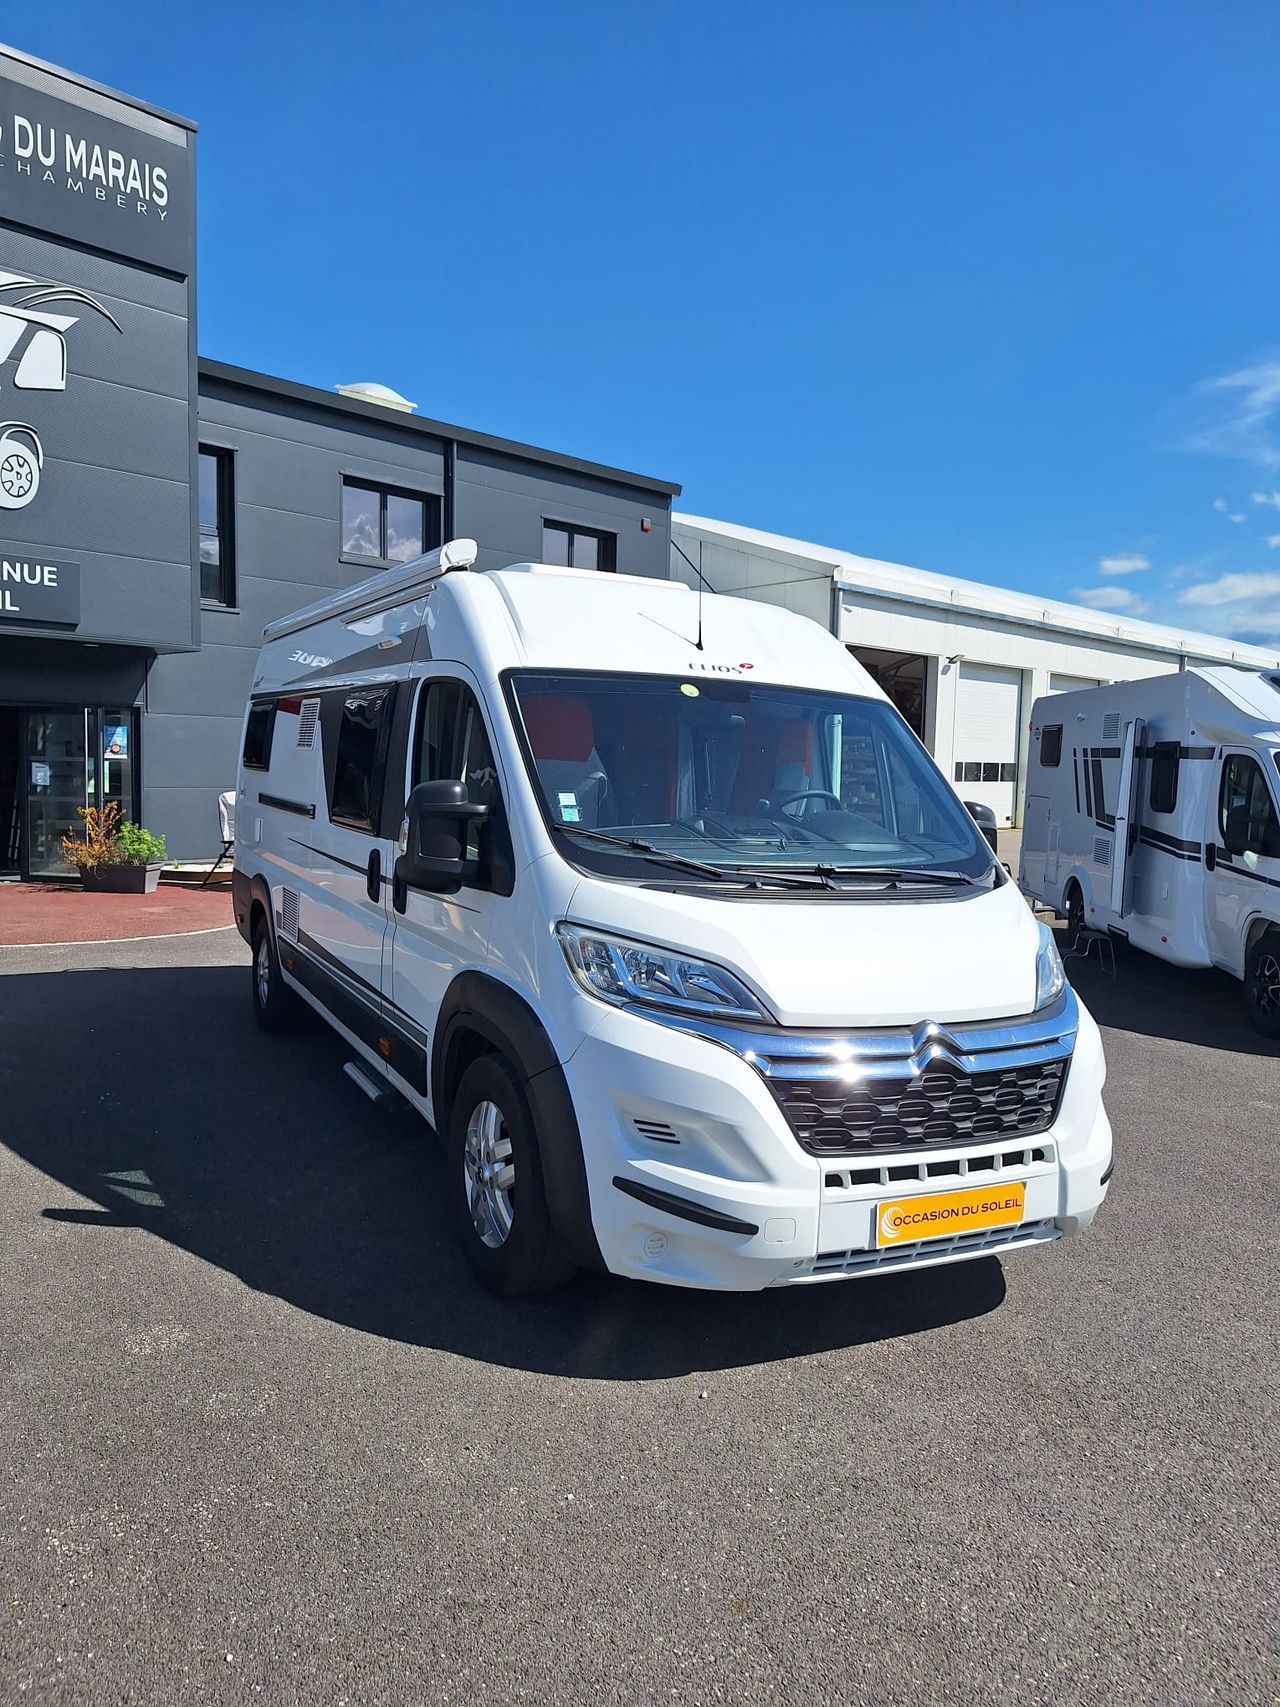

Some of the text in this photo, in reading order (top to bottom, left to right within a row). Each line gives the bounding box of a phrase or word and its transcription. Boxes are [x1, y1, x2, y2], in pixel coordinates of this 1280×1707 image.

[14, 115, 169, 207] DU MARAIS
[0, 561, 58, 587] NUE
[893, 1198, 1022, 1227] OCCASION DU SOLEIL
